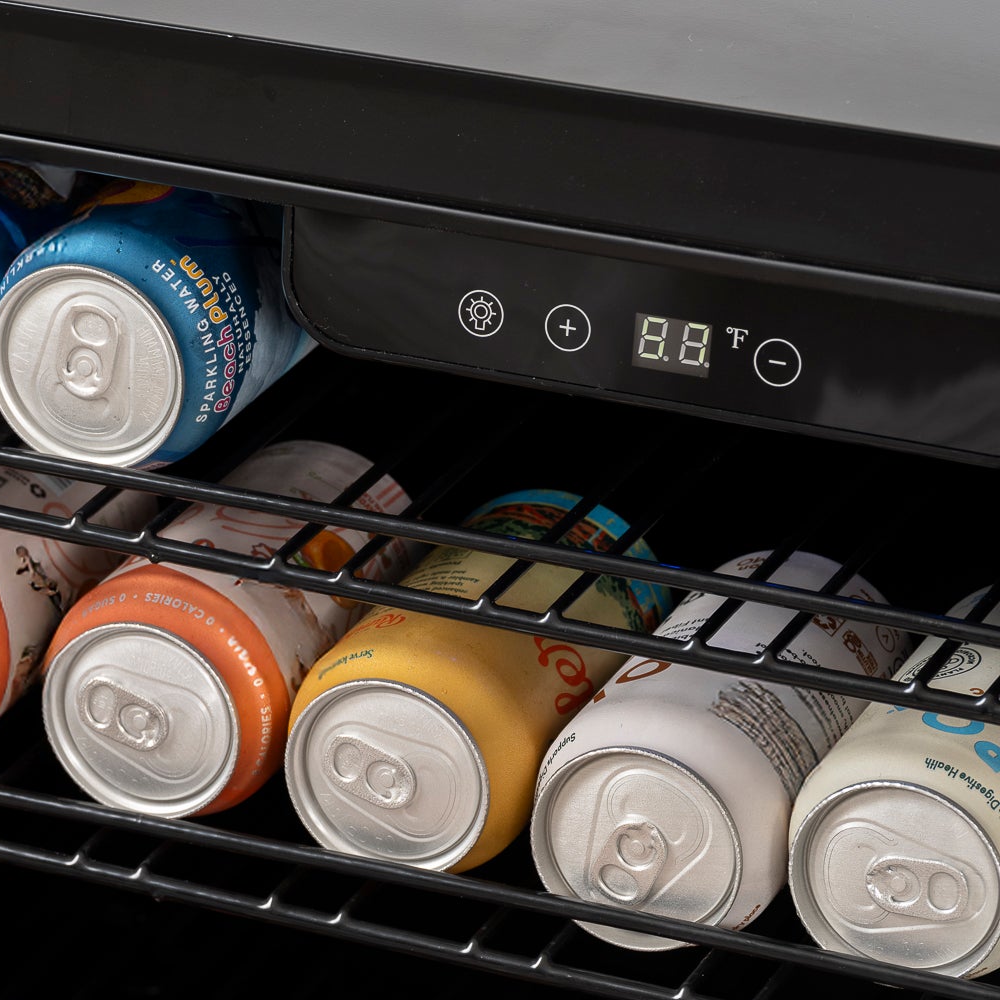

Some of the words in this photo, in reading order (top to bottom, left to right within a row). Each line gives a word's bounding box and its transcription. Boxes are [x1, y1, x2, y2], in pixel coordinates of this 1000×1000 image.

[152, 259, 200, 314] WATER
[211, 275, 245, 374] NATURALLY
[222, 271, 253, 364] ESSENCED
[196, 317, 218, 423] SPARKLING
[213, 324, 236, 413] Beach
[144, 592, 206, 620] CALORIES
[546, 733, 576, 766] Supports
[924, 756, 958, 779] Health
[958, 770, 1000, 811] Digestive
